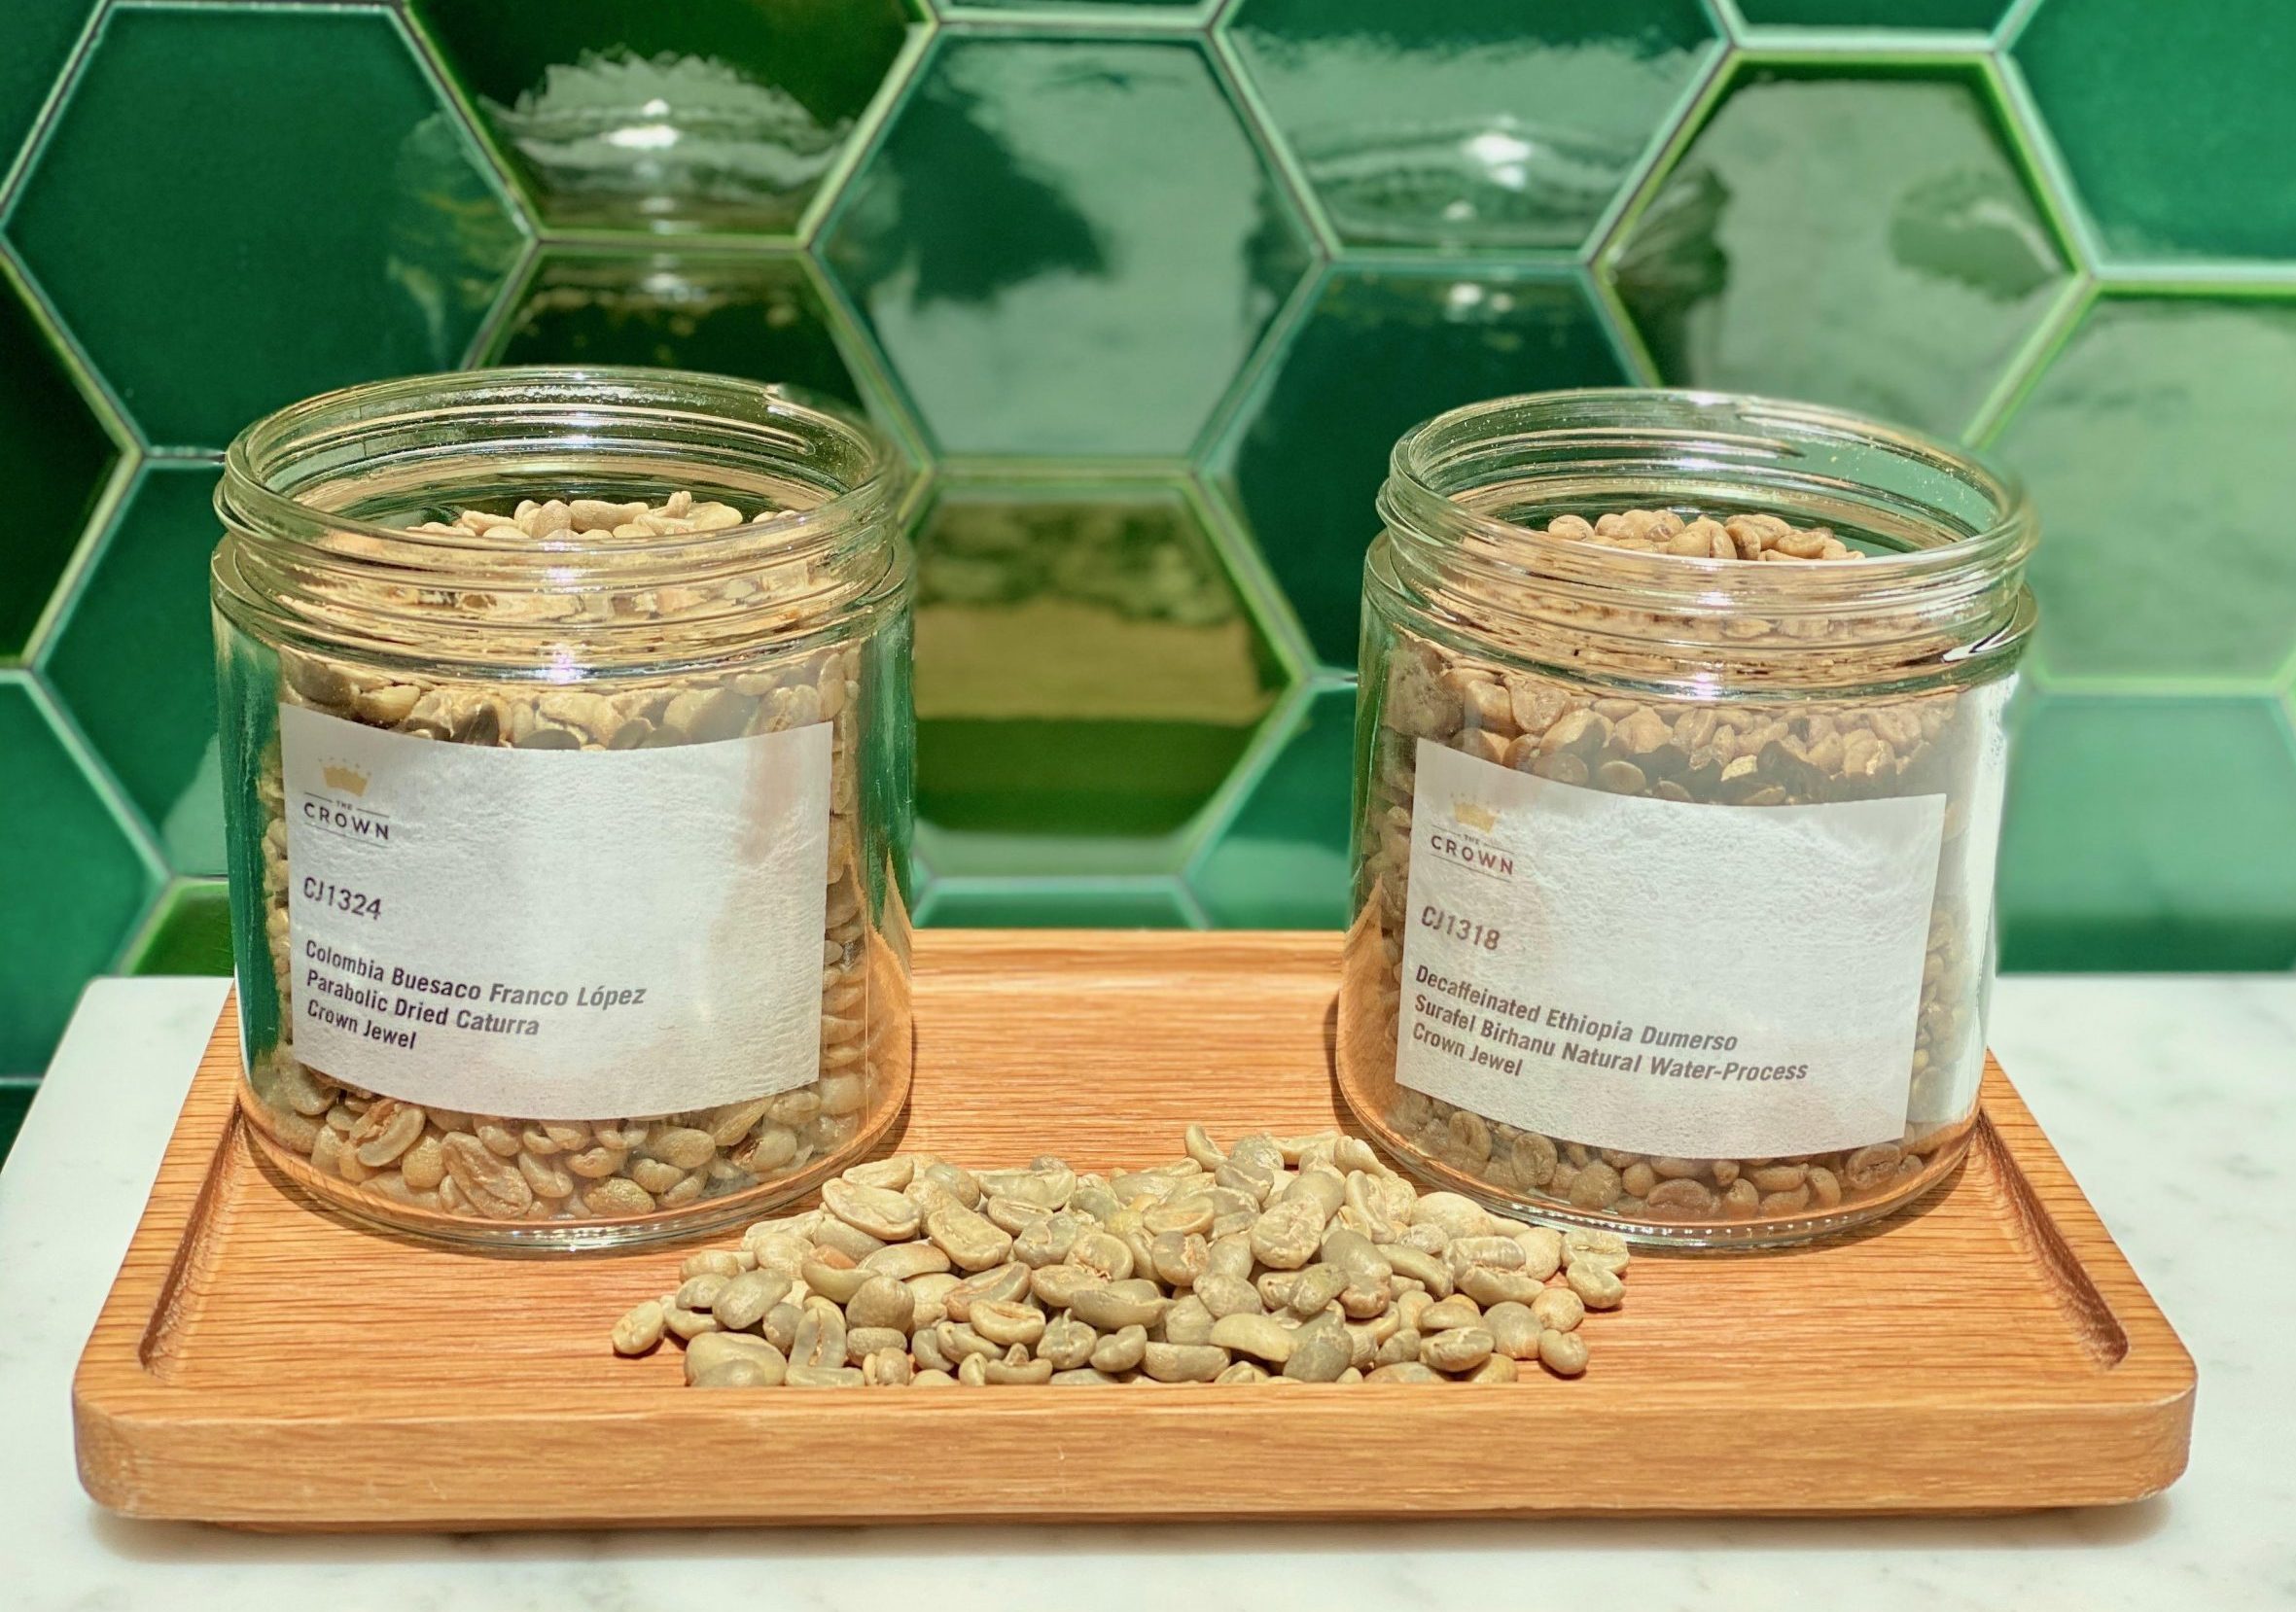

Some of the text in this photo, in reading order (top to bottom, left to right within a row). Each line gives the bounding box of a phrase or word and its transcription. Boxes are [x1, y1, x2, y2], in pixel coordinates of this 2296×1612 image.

[304, 802, 389, 840] CROWN
[336, 800, 352, 811] THE
[1431, 835, 1513, 875] CROWN
[1464, 833, 1480, 845] THE
[303, 877, 382, 920] CJ1324
[1422, 905, 1501, 951] CJ1318
[306, 939, 647, 1010] Colombia Buesaco Franco López
[306, 969, 539, 1035] Parabolic Dried Caturra
[307, 999, 417, 1049] Crown Jewel
[1416, 965, 1738, 1051] Decaffeinated Ethiopia Dumerso
[1413, 1023, 1523, 1076] Crown Jewel
[1414, 995, 1808, 1081] Surafel Birhanu Natural Water-Process
